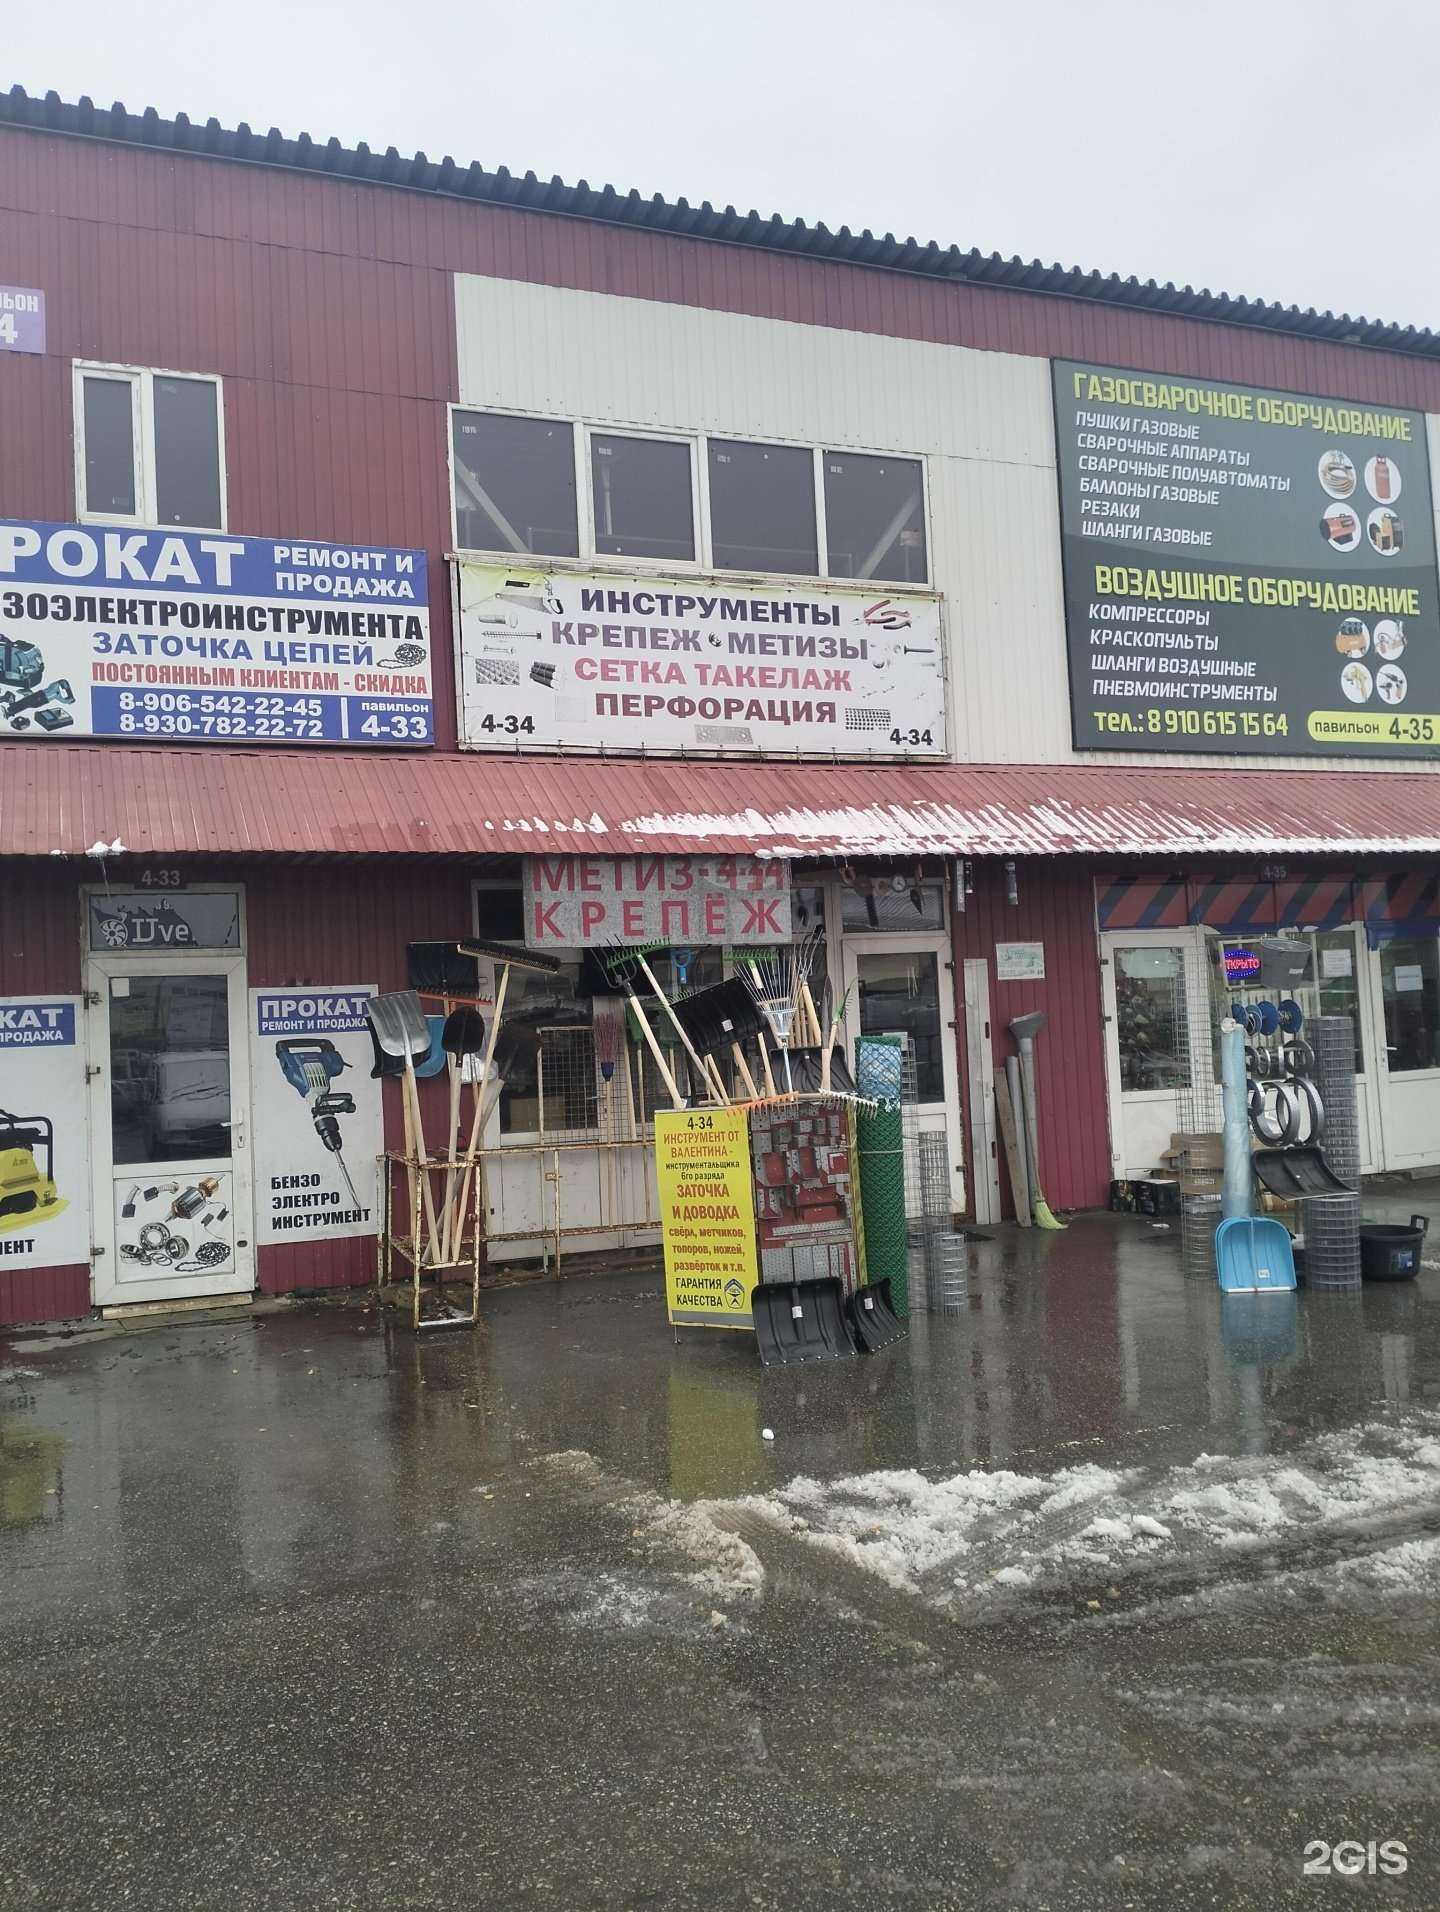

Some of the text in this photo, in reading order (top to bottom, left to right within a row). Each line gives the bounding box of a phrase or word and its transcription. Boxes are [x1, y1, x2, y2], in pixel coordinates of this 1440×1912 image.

[1073, 373, 1412, 441] ГАЗОСВАРОЧНОЕ ОБОРУДОВАНИЕ
[1076, 411, 1200, 440] ПУШКИ ГАЗОВЫЕ
[1077, 433, 1250, 466] СВАРОЧНЫЕ АППАРАТЫ
[1079, 455, 1290, 492] СВАРОЧНЫЕ ПОЛУАВТОМАТЫ
[1080, 477, 1220, 505] БАЛЛОНЫ ГАЗОВЫЕ
[1081, 500, 1140, 518] РЕЗАКИ
[1082, 520, 1213, 546] ШЛАНГИ ГАЗОВЫЕ
[0, 525, 244, 586] РОКАТ
[274, 546, 413, 573] РЕМОНТ И
[277, 571, 415, 598] ПРОДАЖА
[1095, 565, 1421, 615] ВОЗДУШНОЕ ОБОРУДОВАНИЕ
[3, 592, 424, 640] ЗОЭЛЕКТРОИНСТРУМЕНТА
[581, 589, 840, 626] ИНСТРУМЕНТЫ
[1089, 603, 1210, 626] КОМПРЕССОРЫ
[92, 632, 373, 667] ЗАТОЧКА ЦЕПЕЙ
[552, 622, 868, 659] КРЕПЕЖ МЕТИЗЫ
[1090, 628, 1219, 651] КРАСКОПУЛЬТЫ
[575, 658, 852, 691] СЕТКА ТАКЕЛАЖ
[1091, 654, 1257, 677] ШЛАНГИ ВОЗДУШНЫЕ
[92, 662, 235, 687] ПОСТОЯННЫМ
[240, 669, 339, 691] КЛИЕНТАМ
[354, 674, 427, 695] СКИДКА
[1093, 679, 1278, 702] ПНЕВМОИНСТРУМЕНТЫ
[119, 693, 322, 717] 8-906-542-22-45
[362, 702, 429, 713] павильон
[596, 693, 836, 725] ПЕРФОРАЦИЯ
[119, 714, 323, 737] 8-930-782-22-72
[361, 715, 428, 739] 4-33
[481, 713, 535, 735] 4-34
[1093, 709, 1289, 736] тел.: 8 910 615 15 64
[1315, 718, 1434, 741] павильон 4-35
[890, 728, 933, 747] 4-34
[141, 870, 181, 886] 4-33
[534, 893, 784, 938] КРЕПЁЖ
[261, 998, 367, 1019] ПРОКАТ
[262, 1018, 368, 1031] РЕМОНТ И ПРОДАЖА
[687, 1116, 713, 1130] 4-34
[664, 1131, 739, 1144] ИНСТРУМЕНТ ОТ
[671, 1146, 728, 1158] ВАЛЕНТИНА
[271, 1173, 320, 1189] БЕНЗО
[677, 1184, 730, 1198] ЗАТОЧКА
[272, 1192, 340, 1209] ЭЛЕКТРО
[272, 1209, 371, 1230] ИНСТРУМЕНТ
[672, 1205, 740, 1221] И ДОВОДКА
[675, 1278, 722, 1289] ГАРАНТИЯ
[676, 1294, 723, 1307] КАЧЕСТВА
